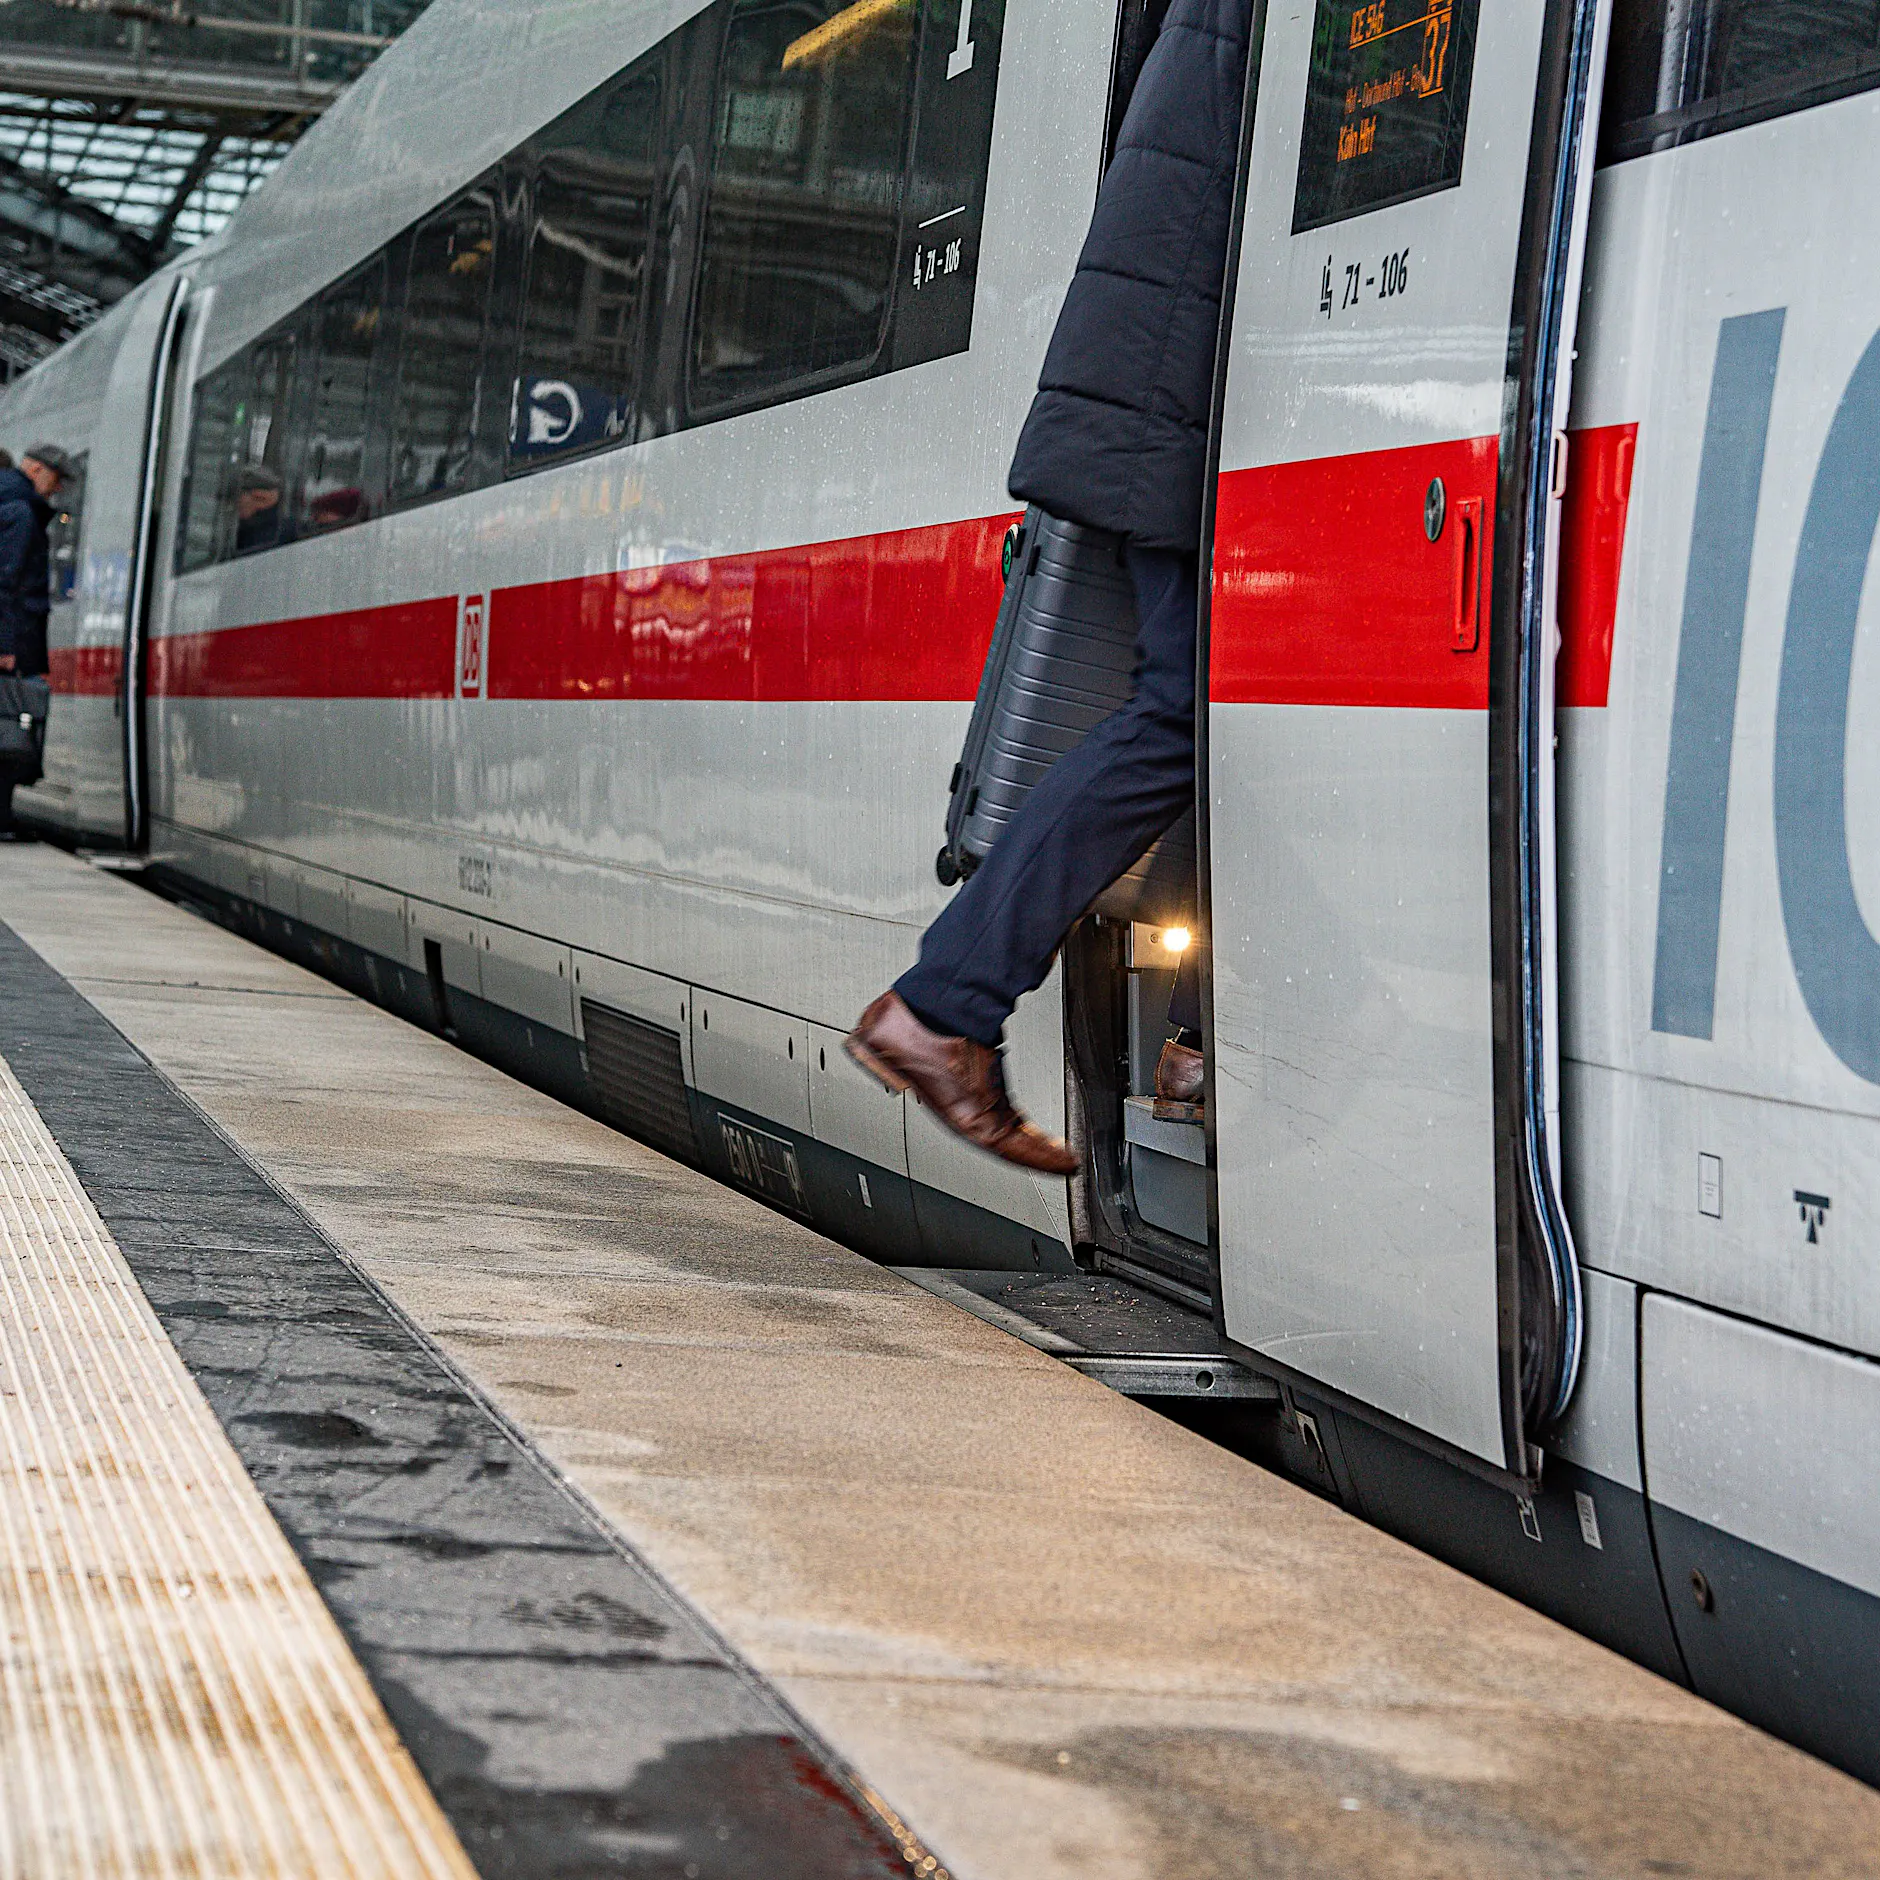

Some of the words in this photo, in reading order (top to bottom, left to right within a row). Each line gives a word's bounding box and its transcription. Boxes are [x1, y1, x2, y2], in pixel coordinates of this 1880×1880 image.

[1422, 12, 1452, 93] 37
[925, 249, 936, 283] 71
[944, 238, 961, 274] 106
[1342, 262, 1361, 310] 71
[1379, 247, 1409, 299] 106
